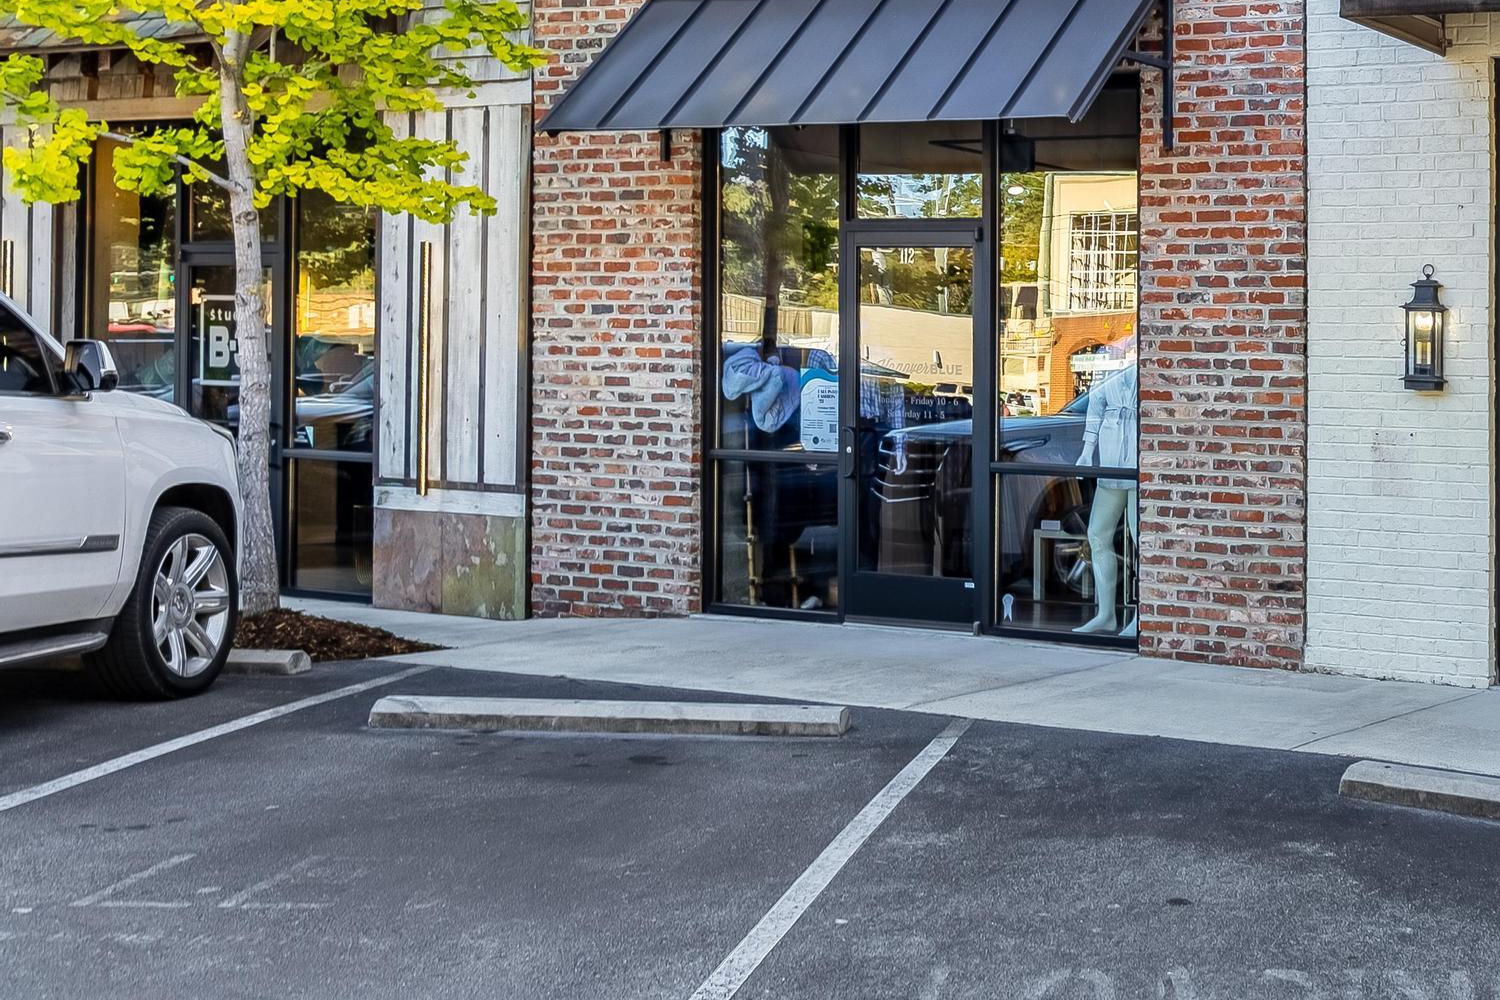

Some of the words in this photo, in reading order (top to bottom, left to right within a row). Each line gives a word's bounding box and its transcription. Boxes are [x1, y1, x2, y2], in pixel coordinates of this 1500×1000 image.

[210, 308, 237, 321] stu
[910, 396, 934, 407] Friday
[937, 397, 946, 406] 10
[953, 398, 959, 406] 6
[887, 409, 921, 420] Srday
[924, 410, 932, 419] 11
[939, 411, 945, 419] 5
